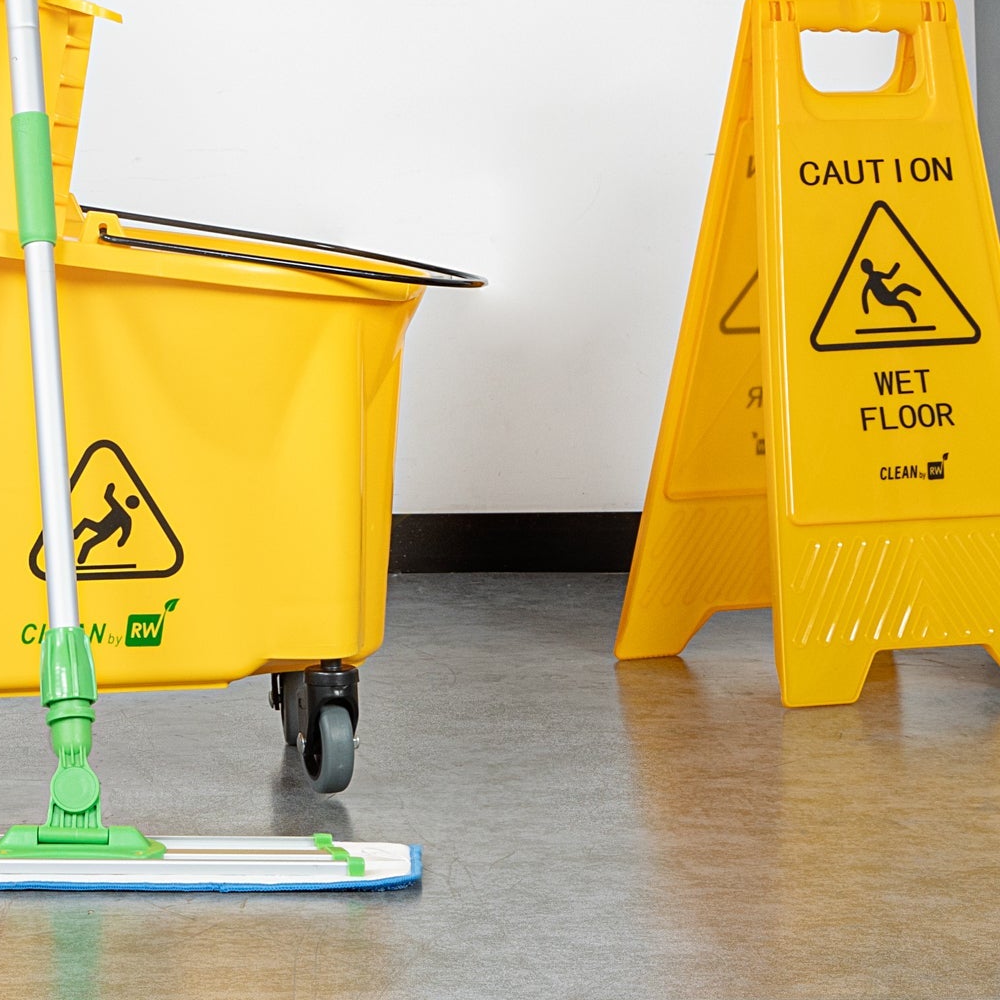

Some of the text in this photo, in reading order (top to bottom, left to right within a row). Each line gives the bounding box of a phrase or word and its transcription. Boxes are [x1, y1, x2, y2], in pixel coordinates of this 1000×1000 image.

[799, 157, 953, 186] CAUTION
[874, 369, 930, 395] WET
[860, 403, 955, 431] FLOOR
[880, 465, 918, 480] CLEAN
[108, 634, 122, 646] by
[130, 622, 163, 638] RW
